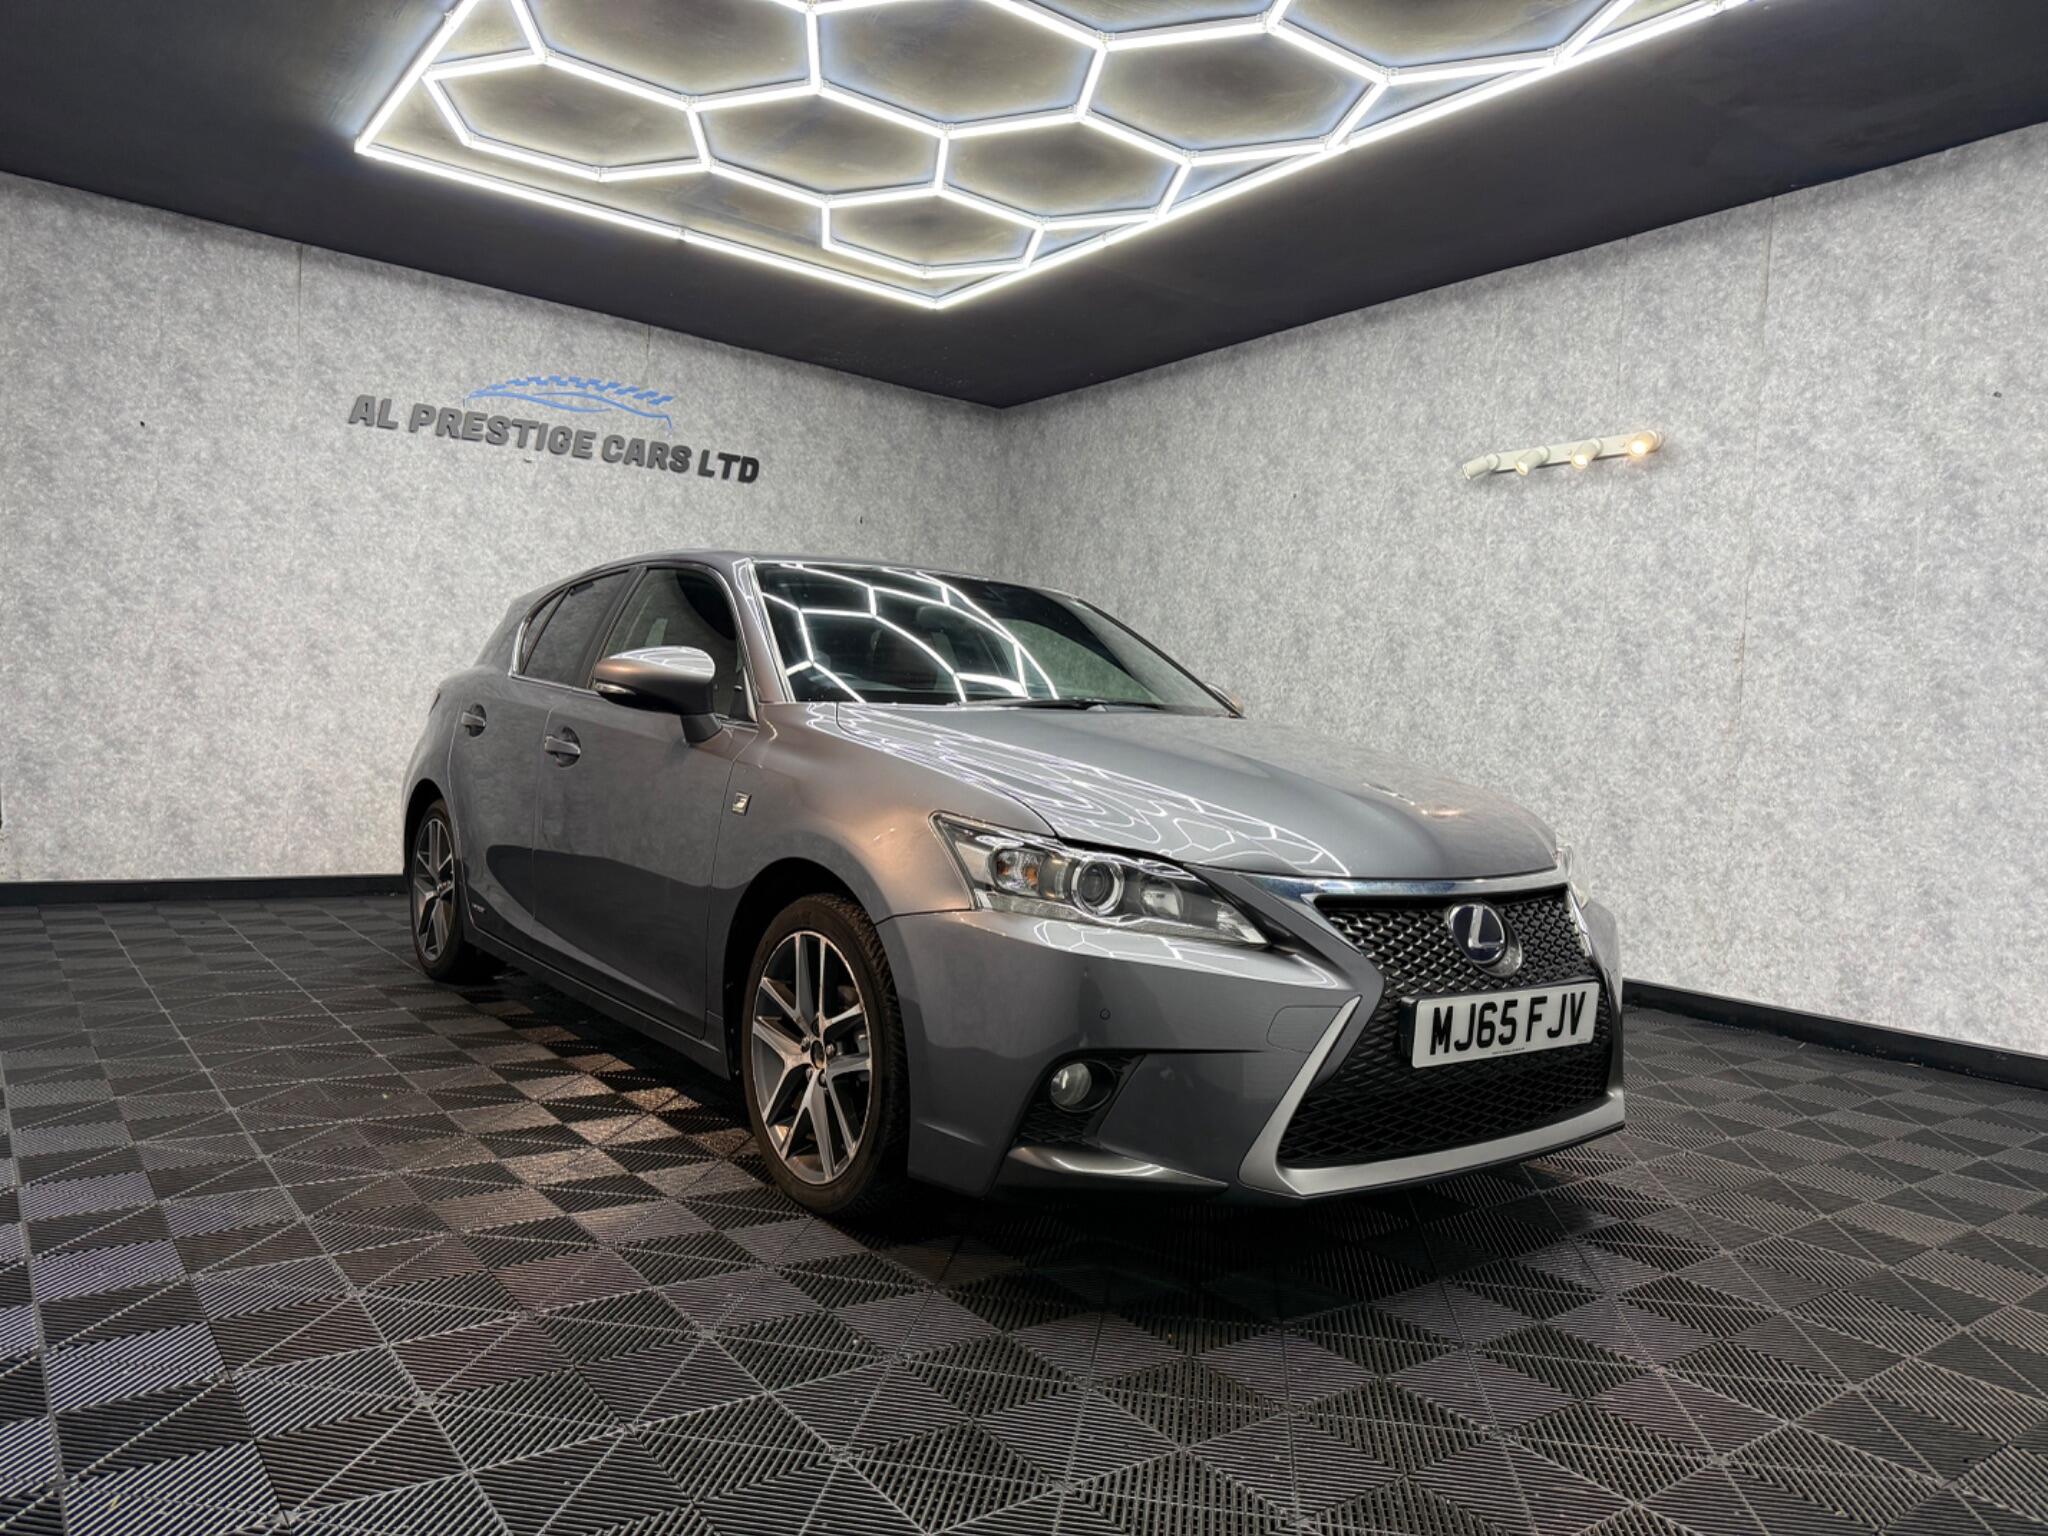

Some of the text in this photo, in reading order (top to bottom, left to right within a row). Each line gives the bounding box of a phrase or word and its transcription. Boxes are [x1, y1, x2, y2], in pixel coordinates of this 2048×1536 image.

[348, 394, 761, 483] AL PRESTIGE CARS LTD
[1429, 991, 1588, 1056] MJ65 FJV
